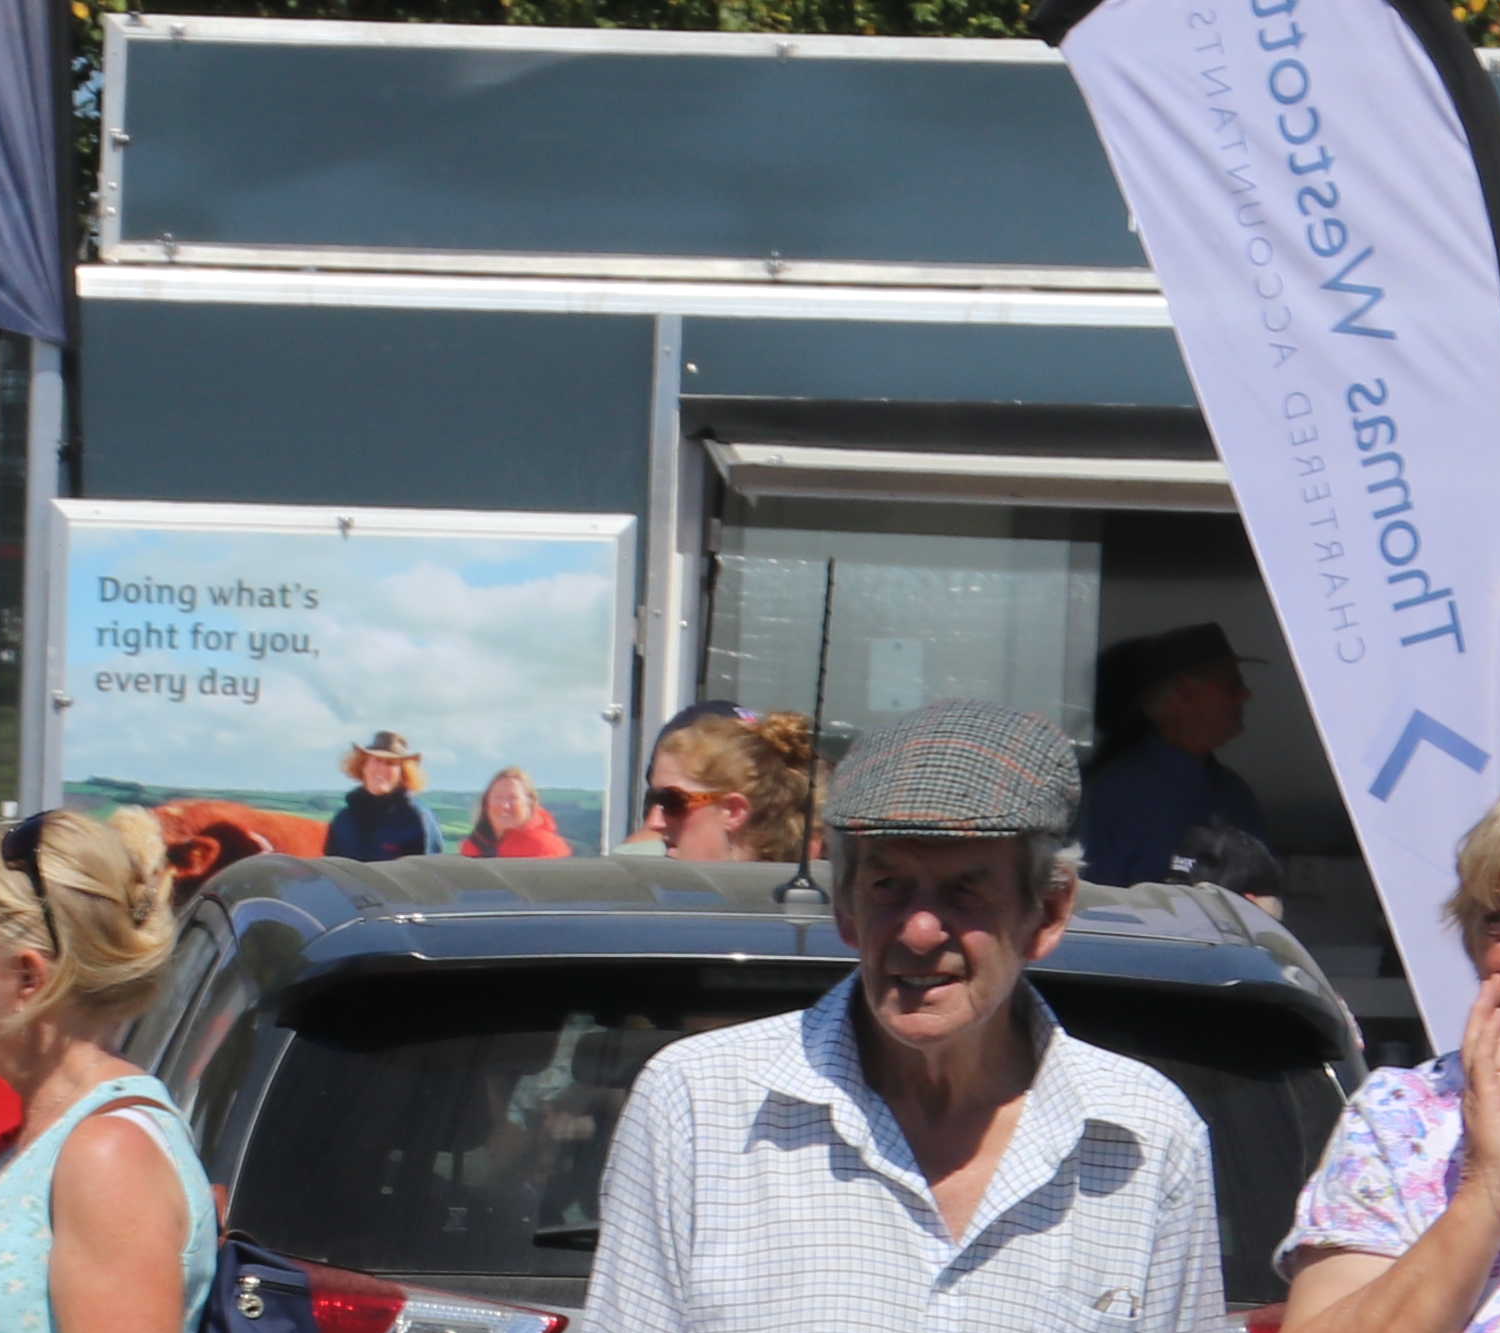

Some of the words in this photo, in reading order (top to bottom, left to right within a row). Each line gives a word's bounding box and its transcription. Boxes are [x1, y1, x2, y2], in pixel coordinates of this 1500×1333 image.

[98, 576, 197, 613] Doing
[208, 580, 320, 609] what's
[96, 621, 179, 656] right
[190, 622, 237, 651] for
[249, 630, 320, 660] you,
[95, 670, 187, 702] every
[198, 667, 261, 704] day
